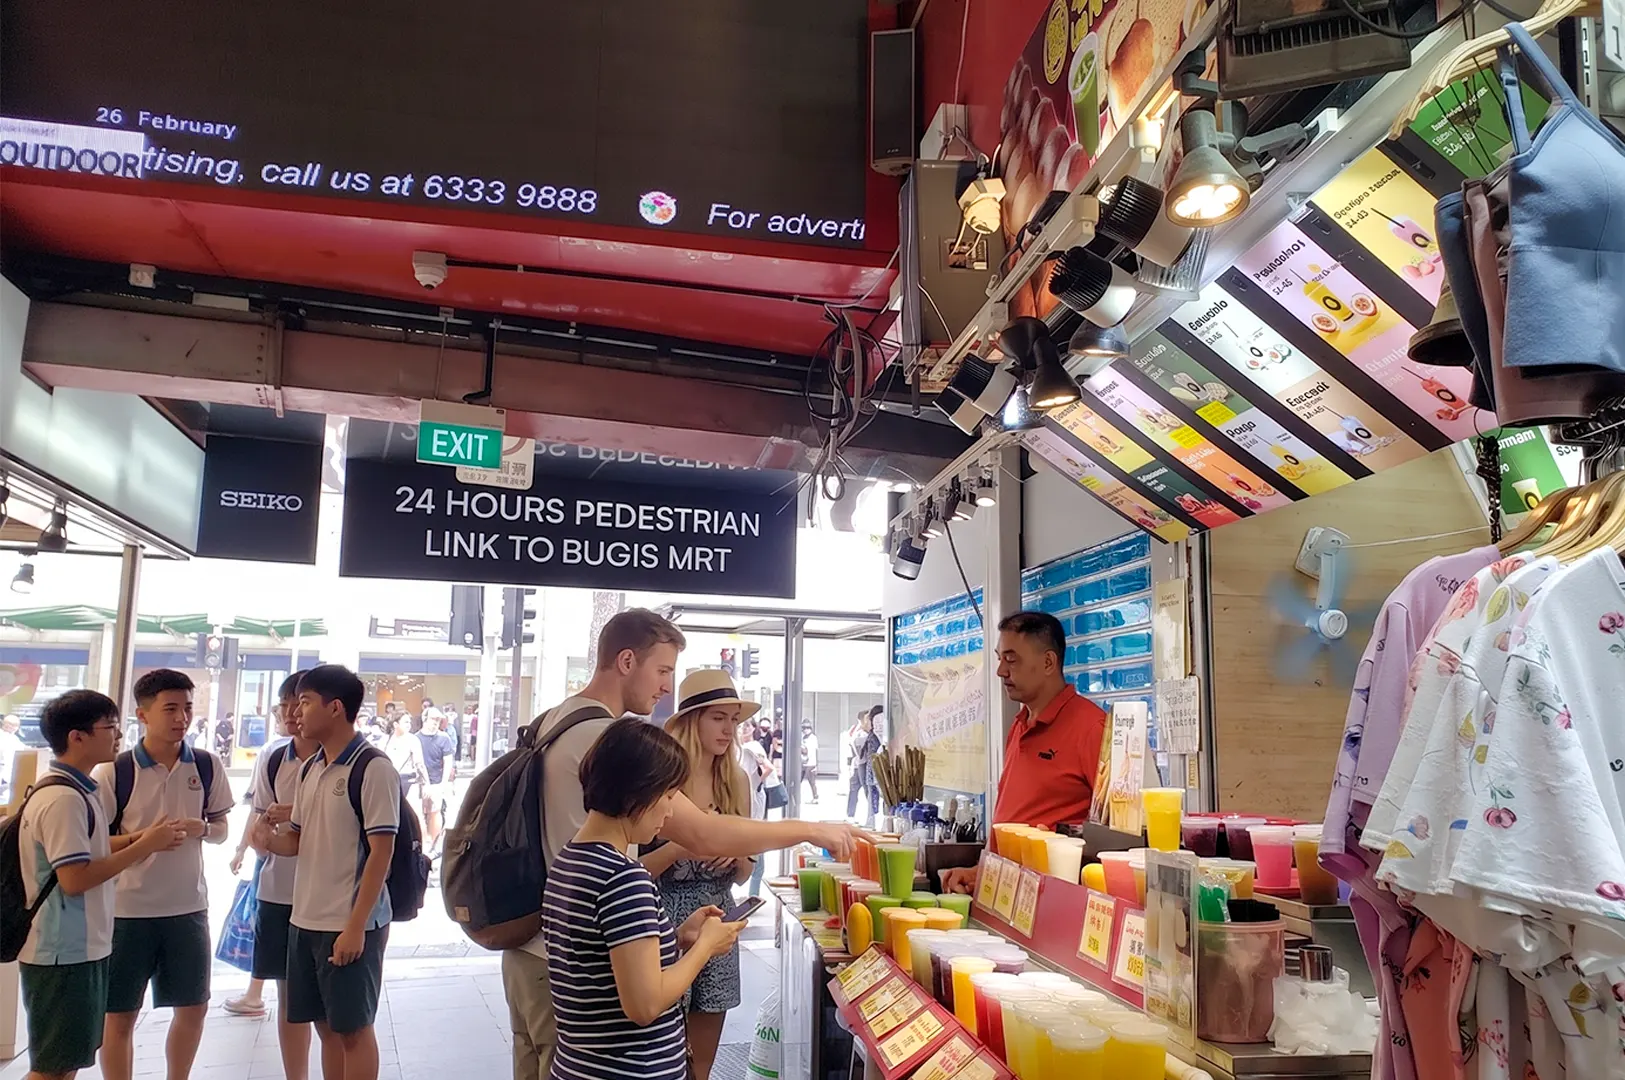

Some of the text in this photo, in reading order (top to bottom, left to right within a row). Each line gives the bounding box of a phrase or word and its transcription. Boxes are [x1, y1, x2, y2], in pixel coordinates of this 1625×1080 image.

[96, 106, 236, 139] 26 February
[0, 140, 140, 179] OUTDOOR
[144, 147, 865, 240] tising, call us at 6333 9888 For adverti
[432, 428, 488, 461] EXIT
[220, 490, 303, 512] SEIKO
[395, 486, 760, 537] 24 HOURS PEDESTRIAN
[425, 530, 732, 573] LINK TO BUGIS MRT
